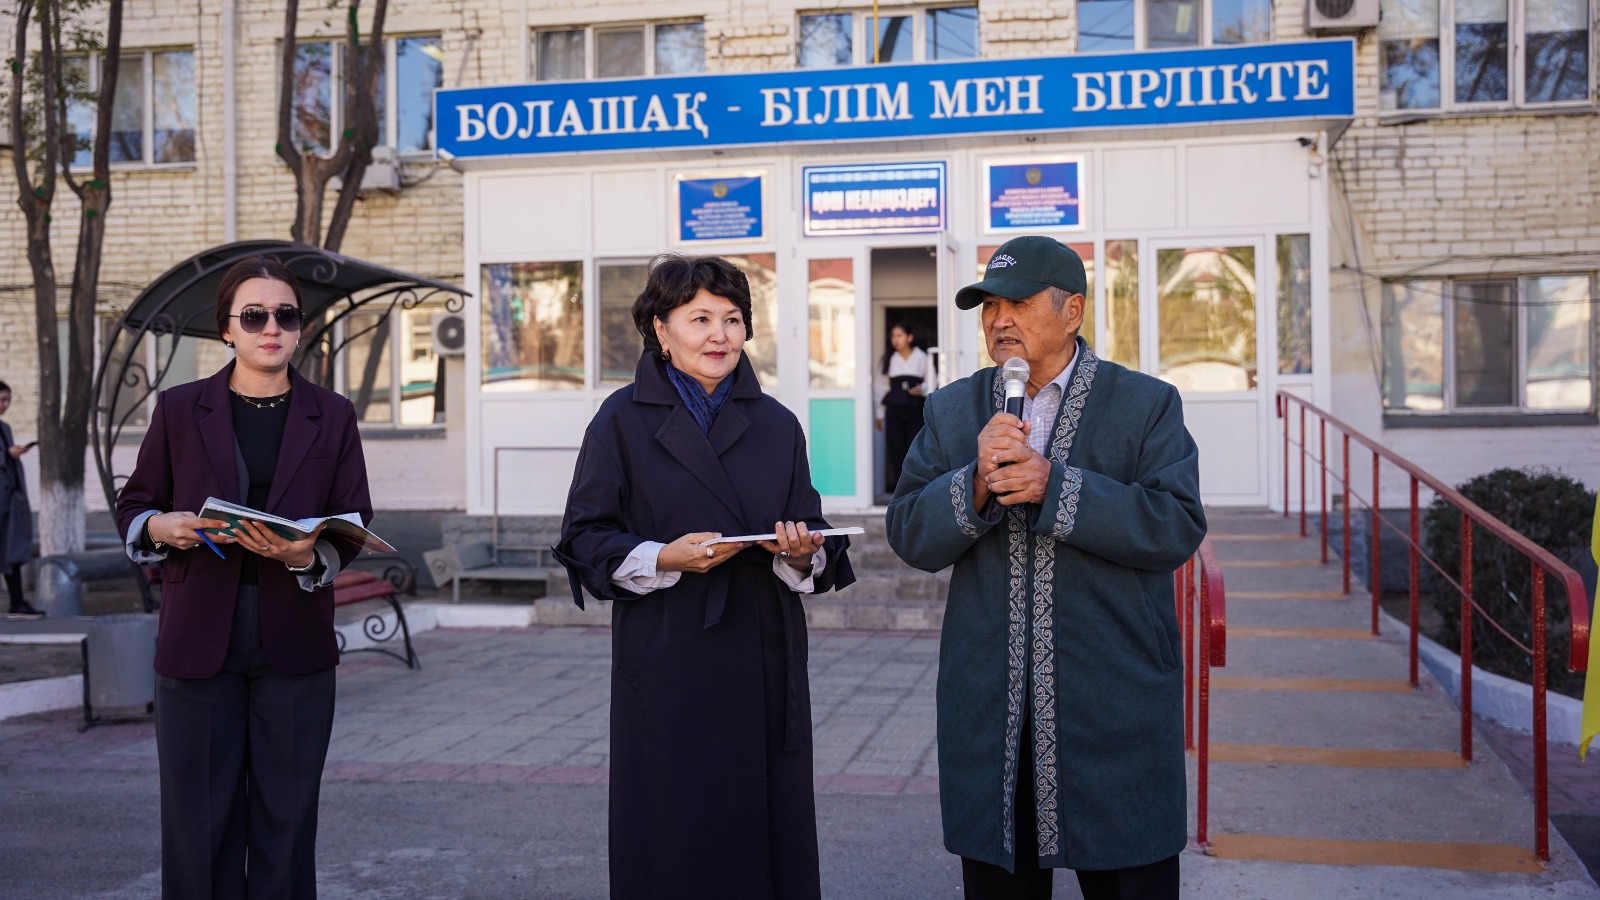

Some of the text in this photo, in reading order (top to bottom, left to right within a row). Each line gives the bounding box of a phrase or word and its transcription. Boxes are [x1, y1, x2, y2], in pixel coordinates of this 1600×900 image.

[455, 92, 709, 142] БОЛАШАҚ
[760, 81, 914, 127] БІЛІМ
[929, 75, 1044, 119] МЕН
[1071, 59, 1330, 112] БІРЛІКТЕ
